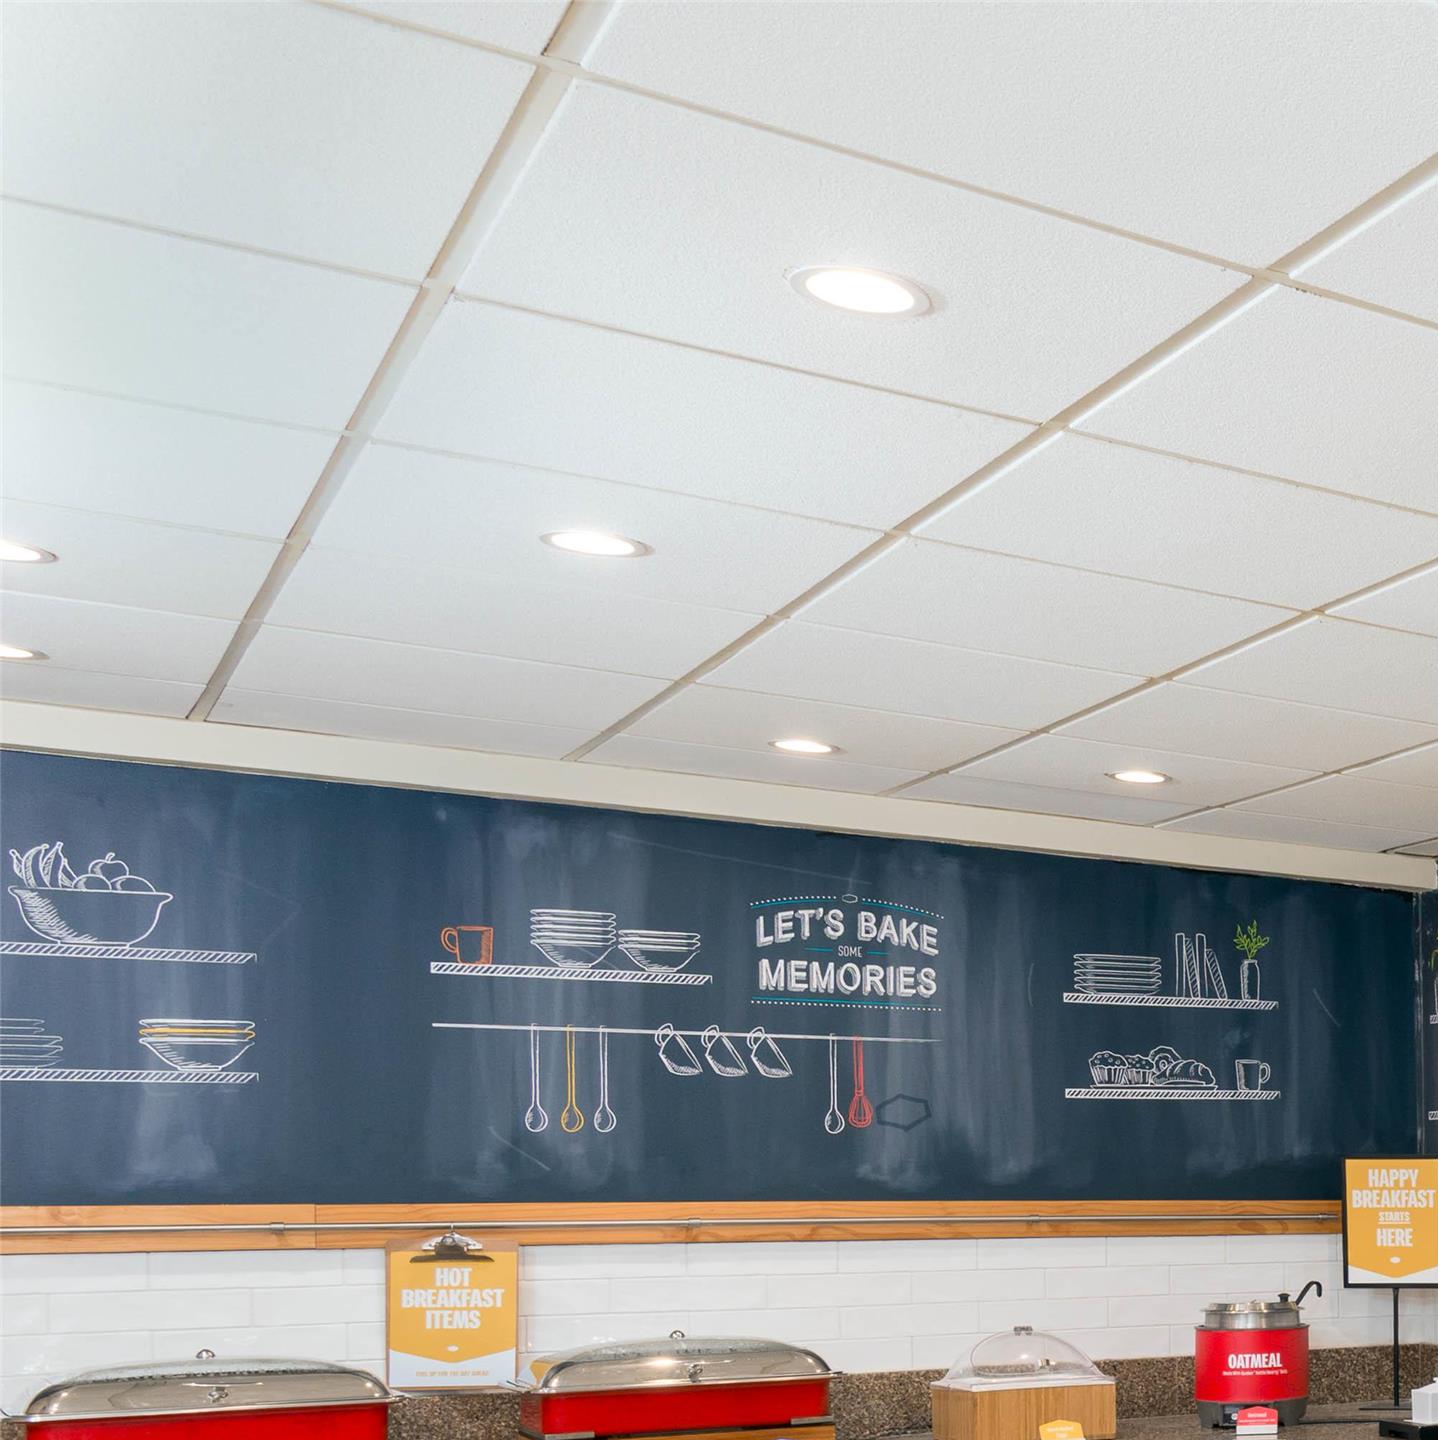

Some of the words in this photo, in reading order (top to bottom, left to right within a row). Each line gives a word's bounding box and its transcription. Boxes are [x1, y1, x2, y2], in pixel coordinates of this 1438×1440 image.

[756, 907, 845, 947] LET'S
[857, 911, 939, 956] BAKE
[837, 945, 863, 957] SOME
[758, 958, 937, 998] MEMORIES
[1368, 1168, 1419, 1188] HAPPY
[1351, 1188, 1436, 1209] BREAKFAST
[1378, 1211, 1411, 1223] STARTS
[1376, 1227, 1413, 1248] HERE
[434, 1267, 472, 1287] HOT
[401, 1288, 505, 1308] BREAKFAST
[425, 1310, 481, 1329] ITEMS
[1227, 1352, 1283, 1369] OATMEAL
